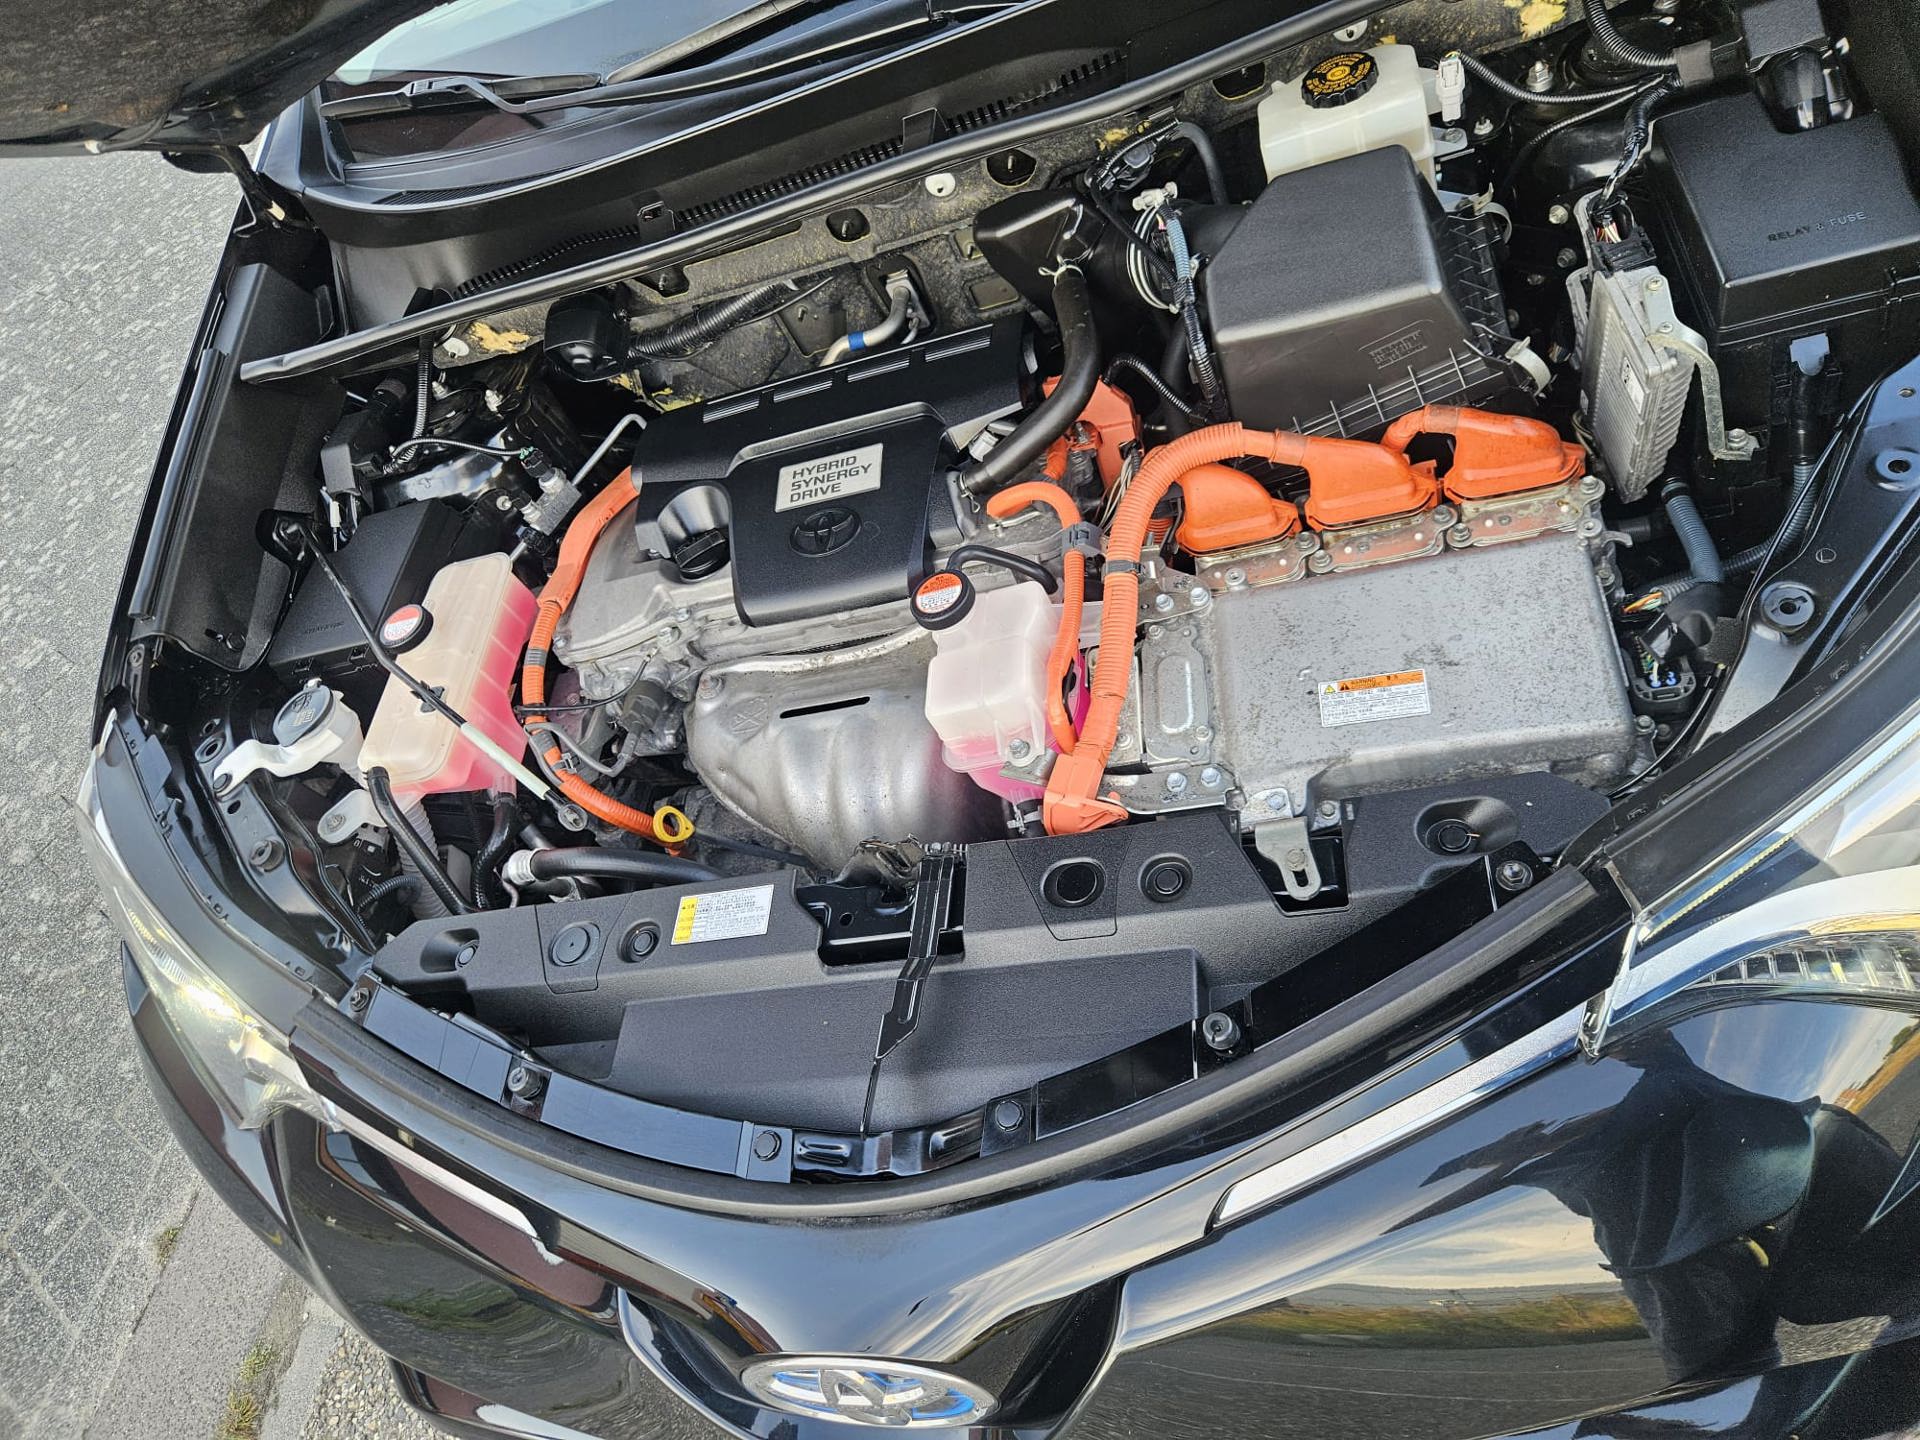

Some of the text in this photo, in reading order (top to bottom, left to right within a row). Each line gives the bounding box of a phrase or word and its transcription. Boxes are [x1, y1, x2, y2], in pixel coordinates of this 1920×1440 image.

[1767, 225, 1810, 241] RELAY
[1828, 211, 1867, 226] FUSE
[790, 463, 873, 492] SYNERGY
[792, 455, 857, 480] HYBRID
[789, 482, 842, 503] DRIVE
